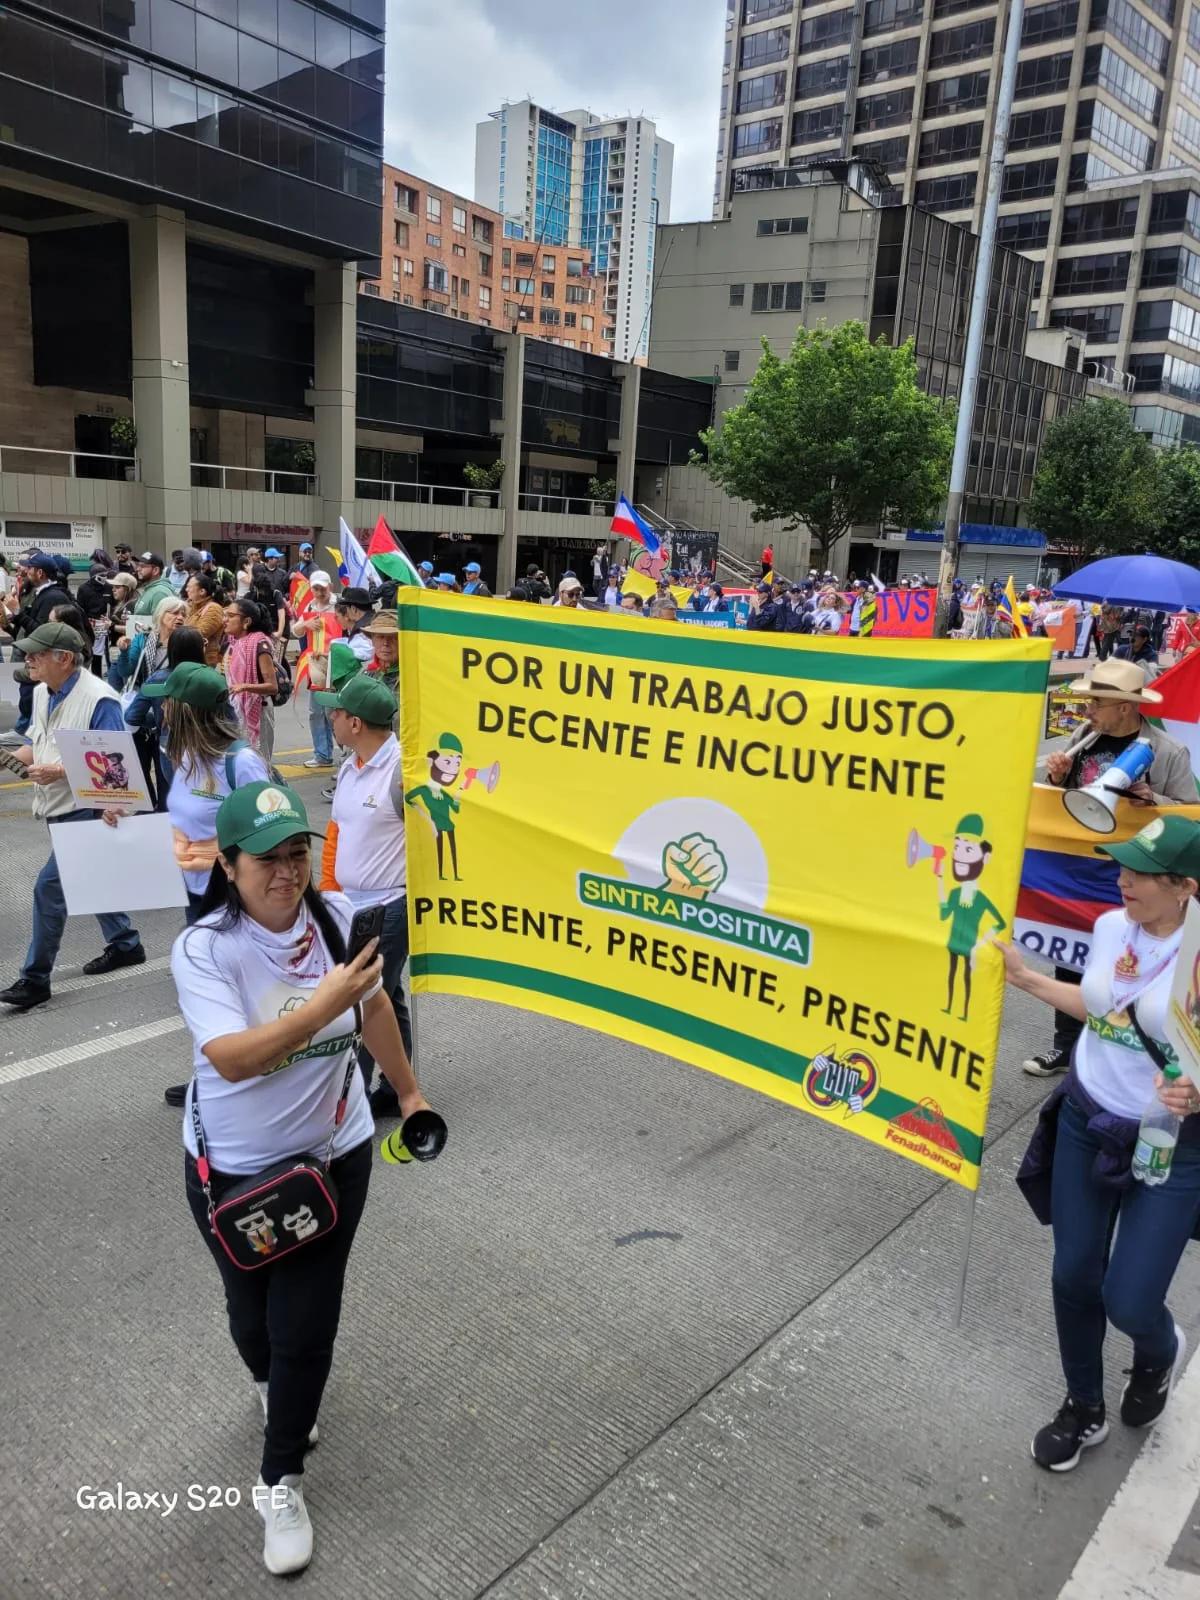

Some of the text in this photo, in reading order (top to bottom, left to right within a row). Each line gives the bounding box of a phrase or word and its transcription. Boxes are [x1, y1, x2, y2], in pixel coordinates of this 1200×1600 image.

[3, 539, 36, 547] EXCHANGE
[876, 591, 930, 622] TVS
[462, 647, 966, 747] POR UN TRABAJO JUSTO,
[478, 701, 946, 801] DECENTE E INCLUYENTE
[583, 880, 805, 956] SINTRAPOSITIVA
[1012, 930, 1091, 966] ORR
[414, 897, 986, 1092] PRESENTE, PRESENTE, PRESENTE
[823, 1060, 861, 1097] CUT
[191, 1102, 204, 1139] KARL
